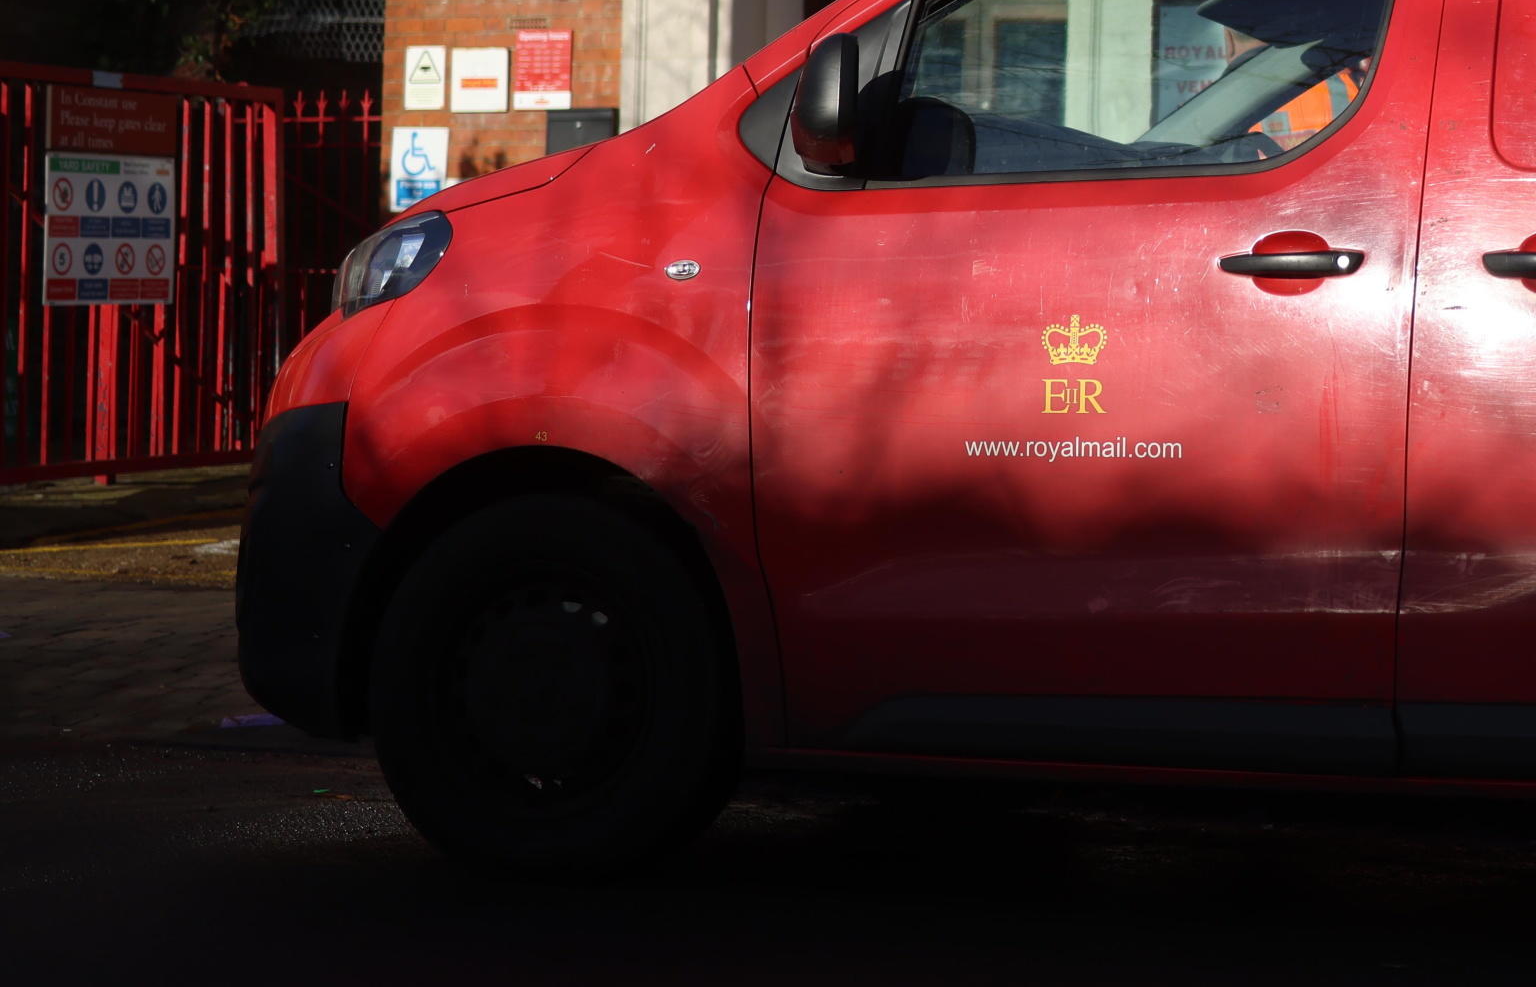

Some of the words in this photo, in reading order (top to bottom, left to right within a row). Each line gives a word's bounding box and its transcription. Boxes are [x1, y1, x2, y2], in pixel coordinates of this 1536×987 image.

[1164, 45, 1226, 60] ROYAL
[60, 88, 72, 105] In
[74, 93, 118, 110] Constant
[122, 100, 138, 111] use
[60, 110, 90, 126] Please
[93, 113, 116, 132] keep
[119, 118, 142, 133] gates
[144, 115, 167, 132] clear
[60, 135, 69, 146] at
[71, 131, 84, 147] all
[87, 133, 114, 150] times
[59, 158, 79, 171] YARD
[82, 160, 112, 173] SAFETY
[535, 430, 548, 442] 43
[965, 436, 1182, 462] www.royalmail.com
